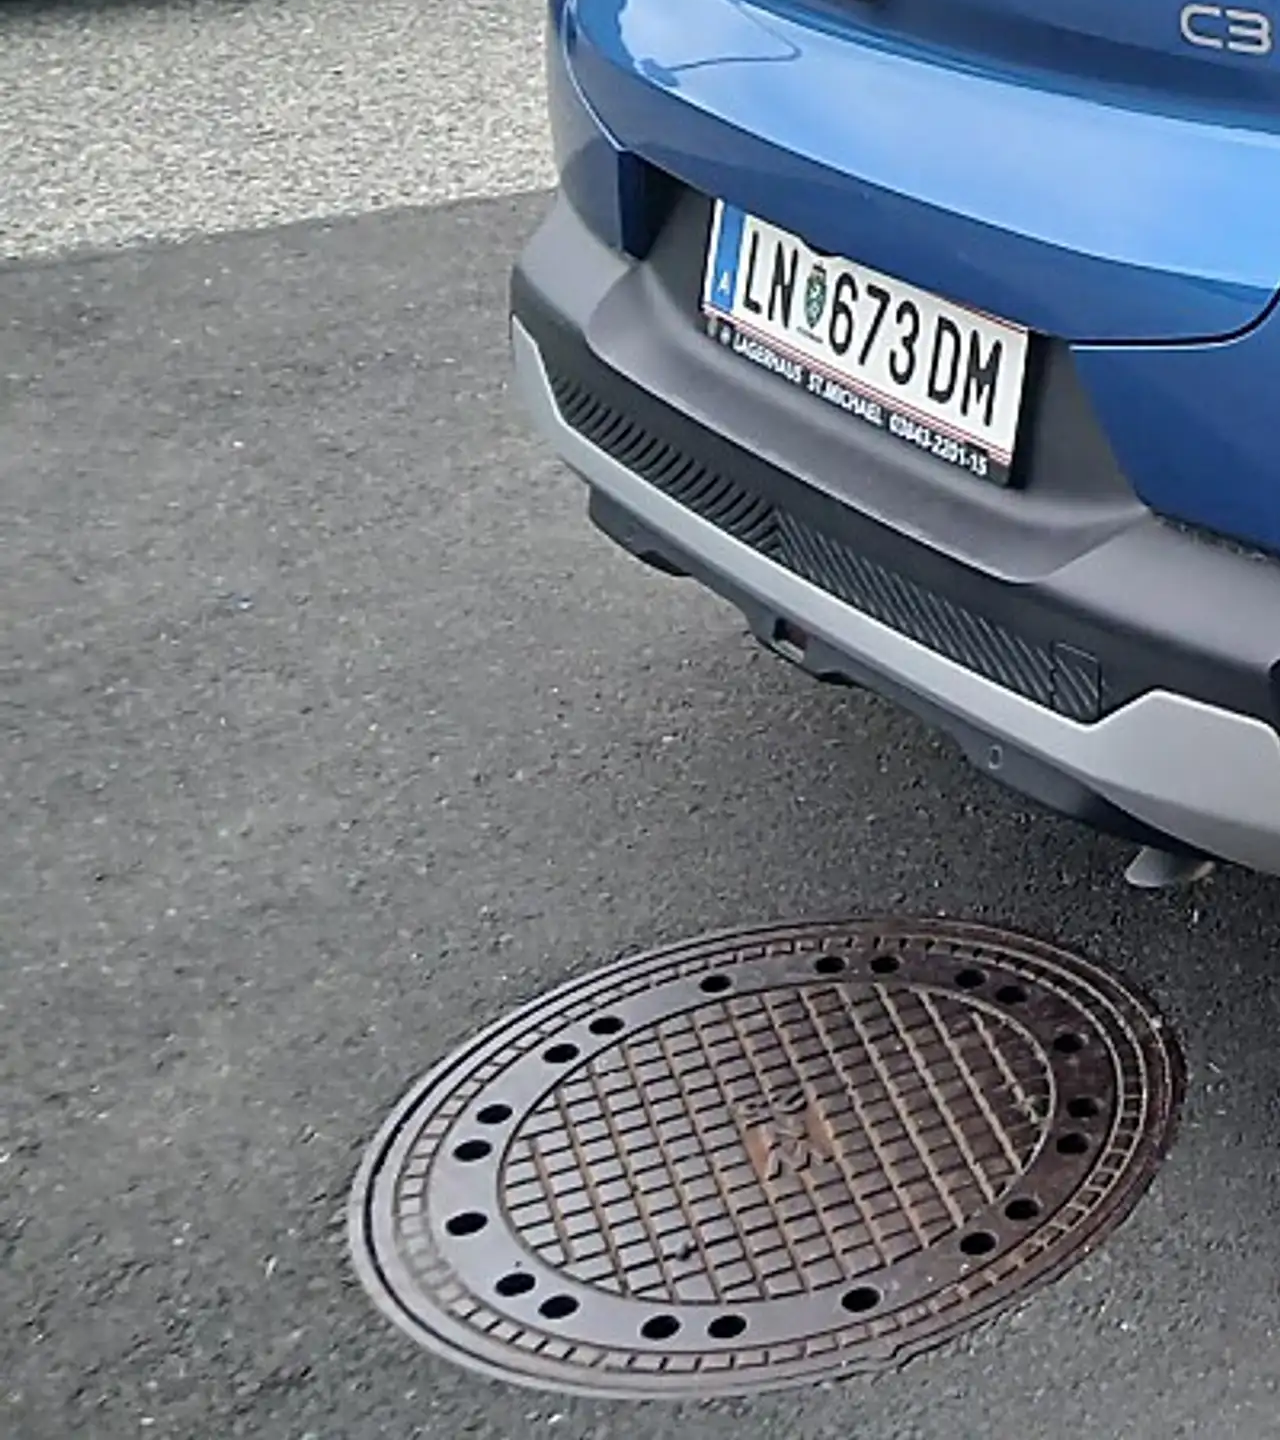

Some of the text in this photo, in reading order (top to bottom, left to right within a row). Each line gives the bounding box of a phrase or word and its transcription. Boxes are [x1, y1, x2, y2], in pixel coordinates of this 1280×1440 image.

[1181, 4, 1272, 55] C3
[743, 230, 1003, 427] LN 673 DM
[733, 330, 803, 384] LAGERHAUS
